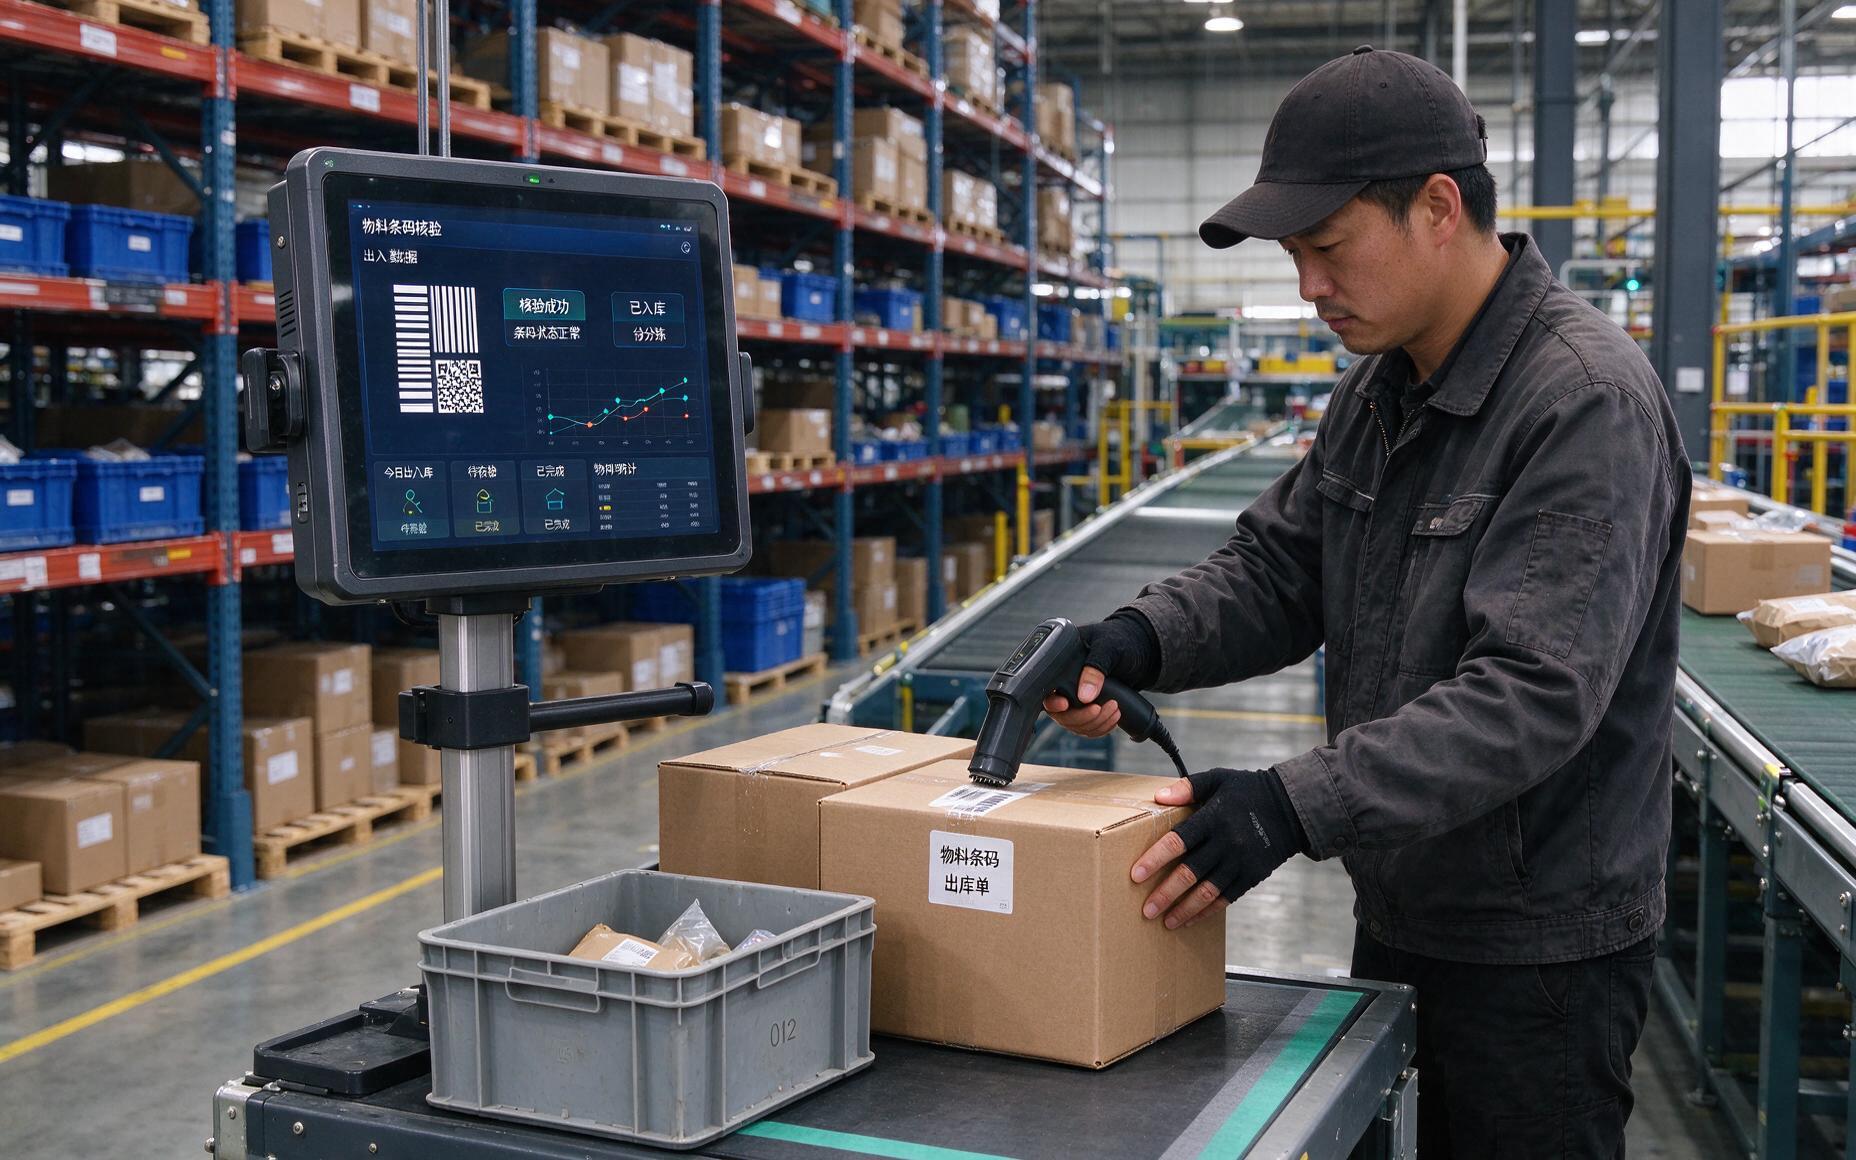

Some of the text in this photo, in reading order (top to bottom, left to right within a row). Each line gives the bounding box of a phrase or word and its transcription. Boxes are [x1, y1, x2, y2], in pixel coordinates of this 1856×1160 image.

[362, 217, 442, 237] 物料条码核验
[519, 298, 569, 315] 核验成功
[629, 300, 666, 316] 已入库
[940, 845, 1000, 868] 物料条码
[944, 873, 990, 896] 出库单
[770, 1018, 797, 1047] 012
